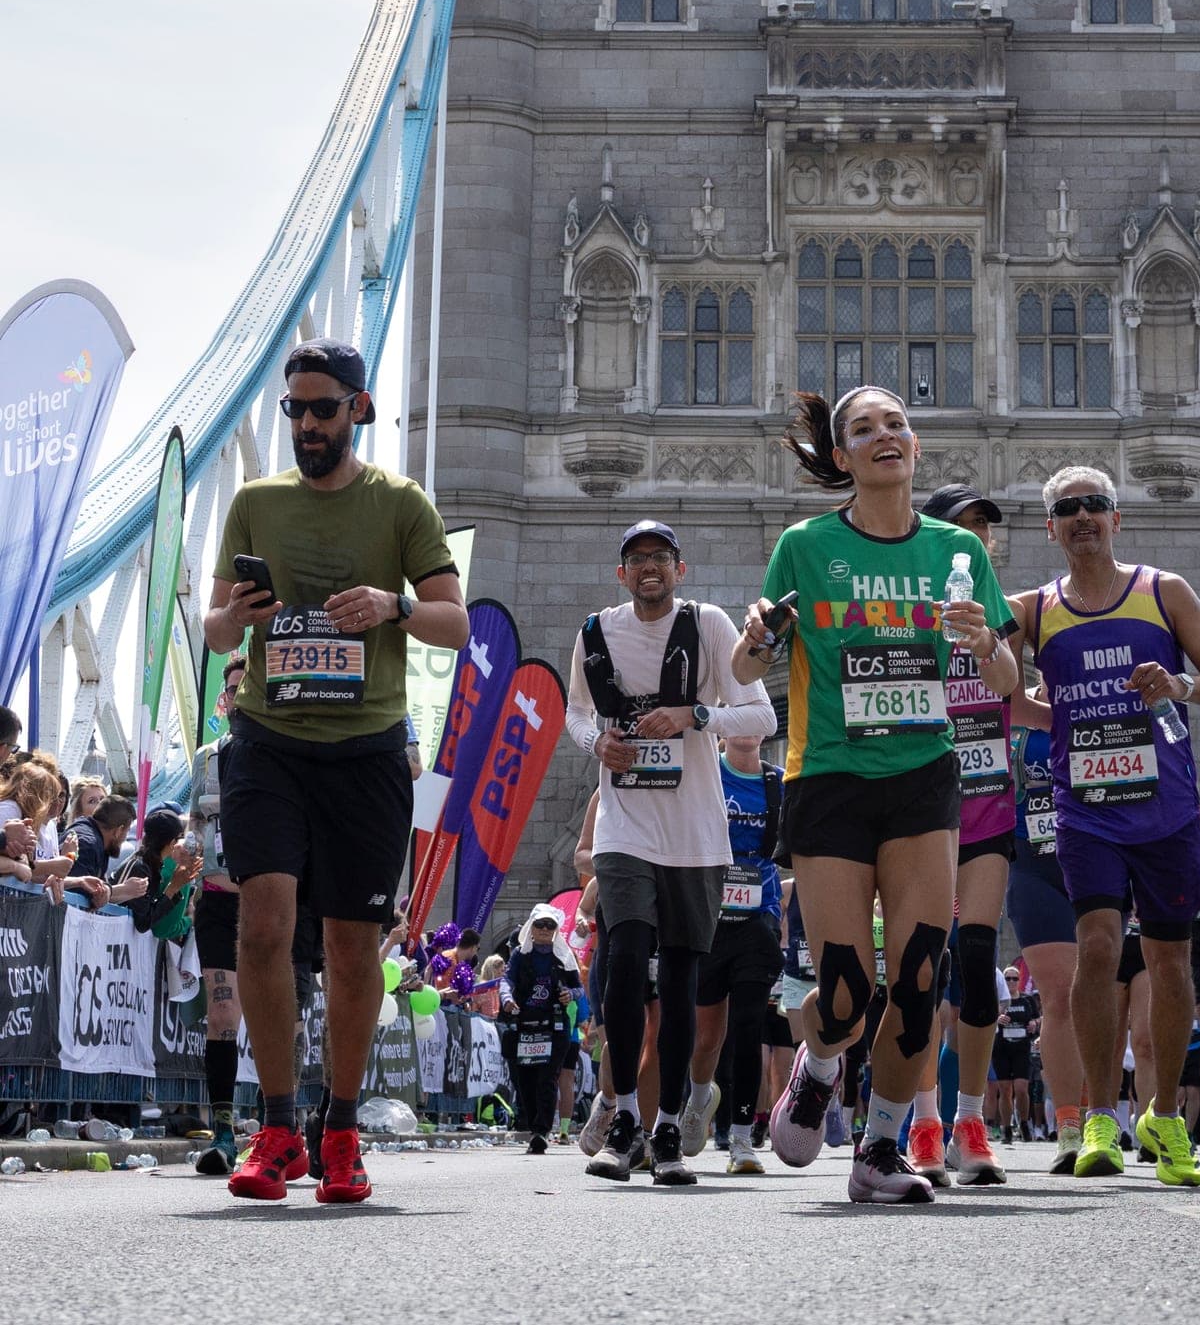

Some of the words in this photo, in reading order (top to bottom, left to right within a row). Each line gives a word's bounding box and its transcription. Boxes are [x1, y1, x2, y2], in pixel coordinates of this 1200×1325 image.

[24, 419, 62, 443] short
[852, 575, 934, 602] HALLE
[272, 615, 304, 636] tcs
[874, 626, 916, 638] LM2026
[278, 646, 348, 672] 73915
[887, 650, 910, 658] TATA
[1082, 645, 1133, 670] NORM
[846, 652, 886, 677] tcs
[887, 658, 936, 667] CONSULTANCY
[888, 666, 922, 676] SERVICES
[301, 691, 319, 699] new
[319, 689, 355, 700] balance
[859, 688, 931, 717] 76815
[1070, 703, 1129, 721] CANCER
[956, 721, 998, 731] CONSULTANCY
[957, 729, 985, 738] SERVICES
[1103, 727, 1147, 738] CONSULTANCY
[1072, 728, 1101, 747] tcs
[1104, 736, 1133, 745] SERVICES
[480, 713, 531, 821] PSP
[1082, 753, 1144, 780] 24434
[962, 787, 976, 795] new
[976, 783, 1004, 794] balance
[1106, 793, 1121, 801] new
[1122, 790, 1152, 800] balance
[1028, 796, 1051, 811] tcs
